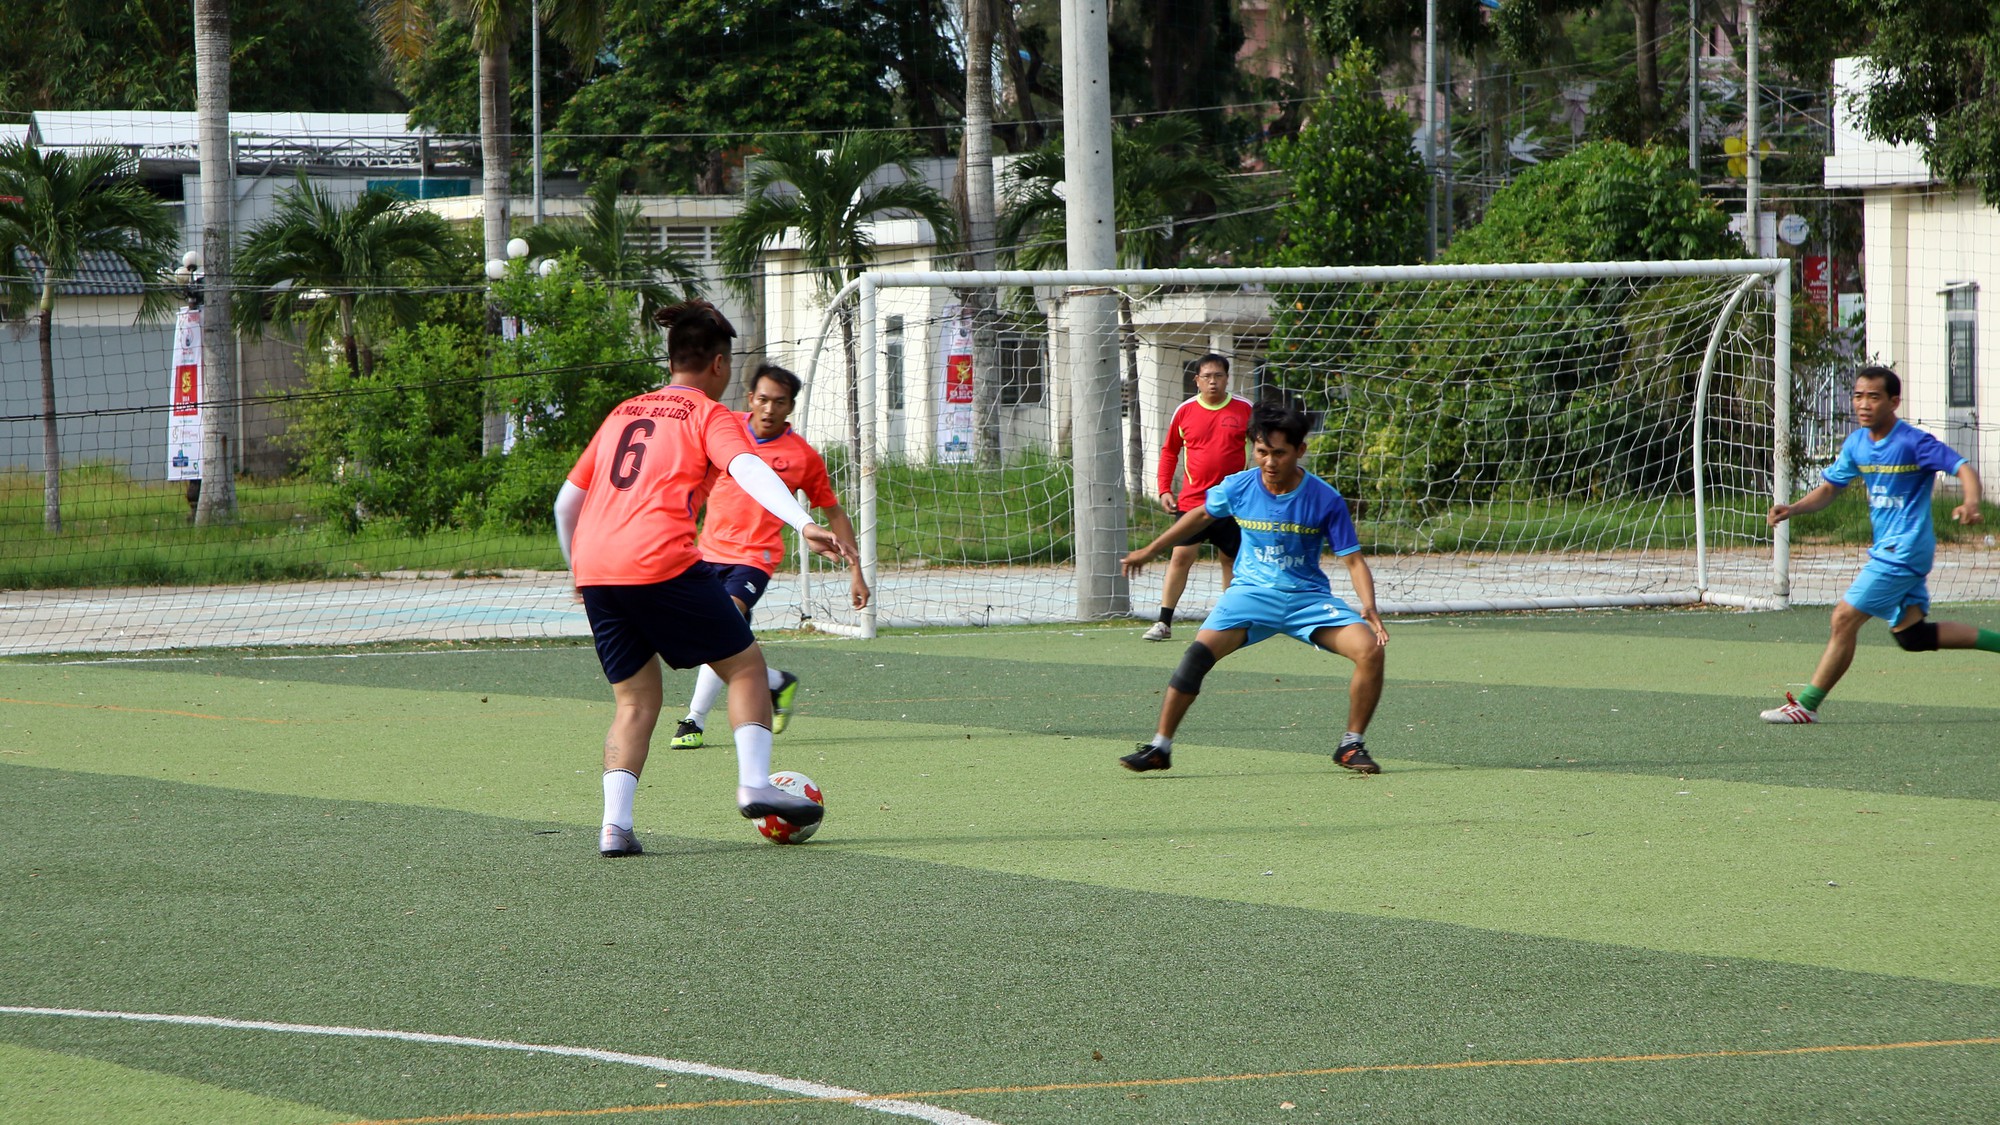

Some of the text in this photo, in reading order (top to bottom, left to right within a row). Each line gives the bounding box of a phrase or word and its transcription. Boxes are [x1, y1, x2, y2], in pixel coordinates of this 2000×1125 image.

[622, 406, 646, 416] MAU
[610, 418, 656, 491] 6
[1322, 603, 1340, 618] 3
